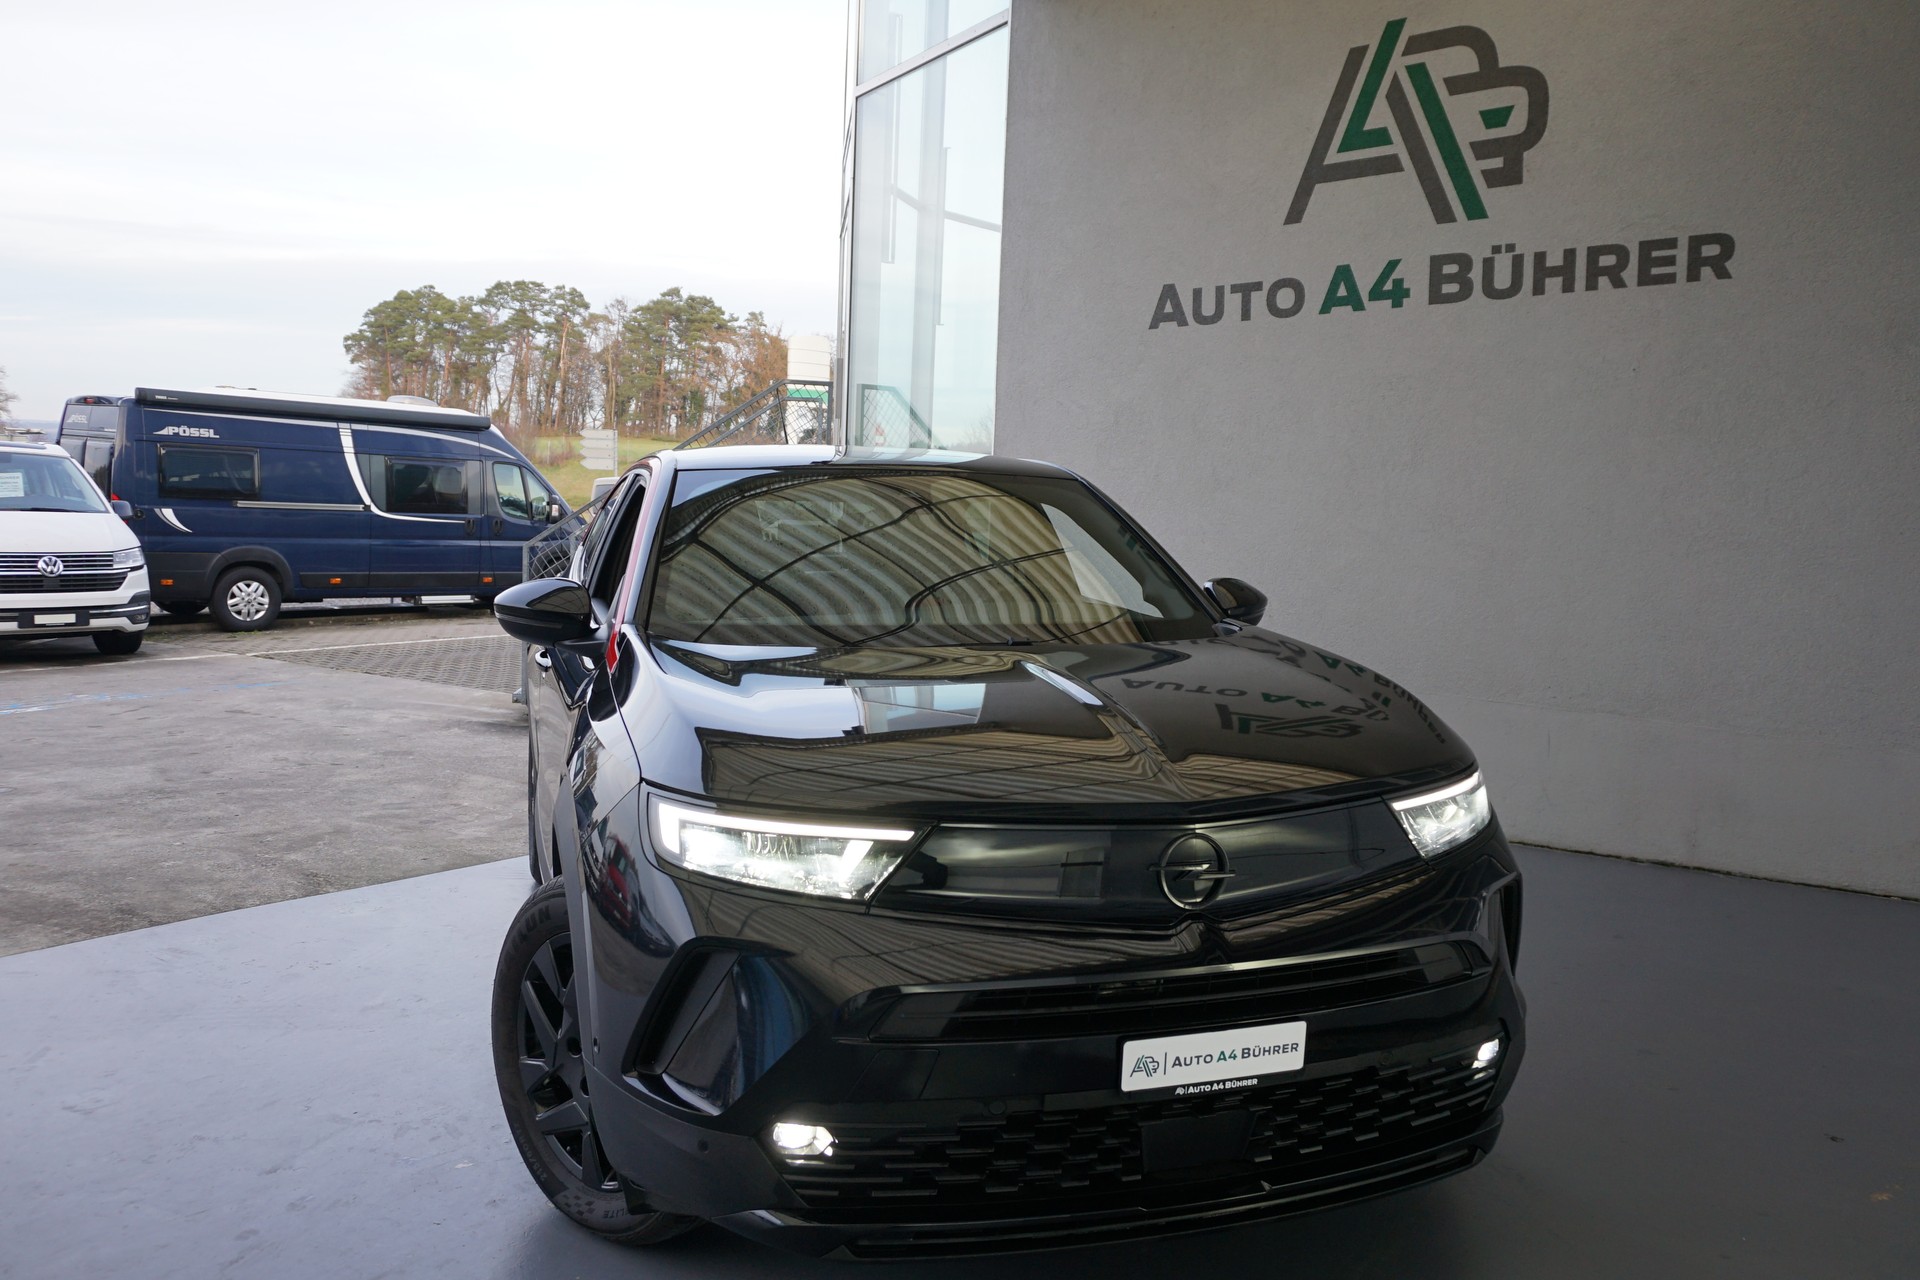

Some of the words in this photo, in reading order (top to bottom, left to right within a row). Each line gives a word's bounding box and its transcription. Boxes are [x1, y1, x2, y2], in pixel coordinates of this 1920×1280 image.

[1148, 277, 1306, 330] AUTO
[1318, 258, 1411, 315] A4
[1428, 232, 1736, 305] BÜHRER
[167, 425, 220, 438] PÖSSL
[1172, 1054, 1214, 1068] AUTO
[1216, 1049, 1238, 1063] A4
[1241, 1042, 1299, 1060] BÜHRER
[1187, 1084, 1211, 1094] AUTO
[1212, 1082, 1224, 1091] A4
[1225, 1078, 1258, 1089] BÜHRER
